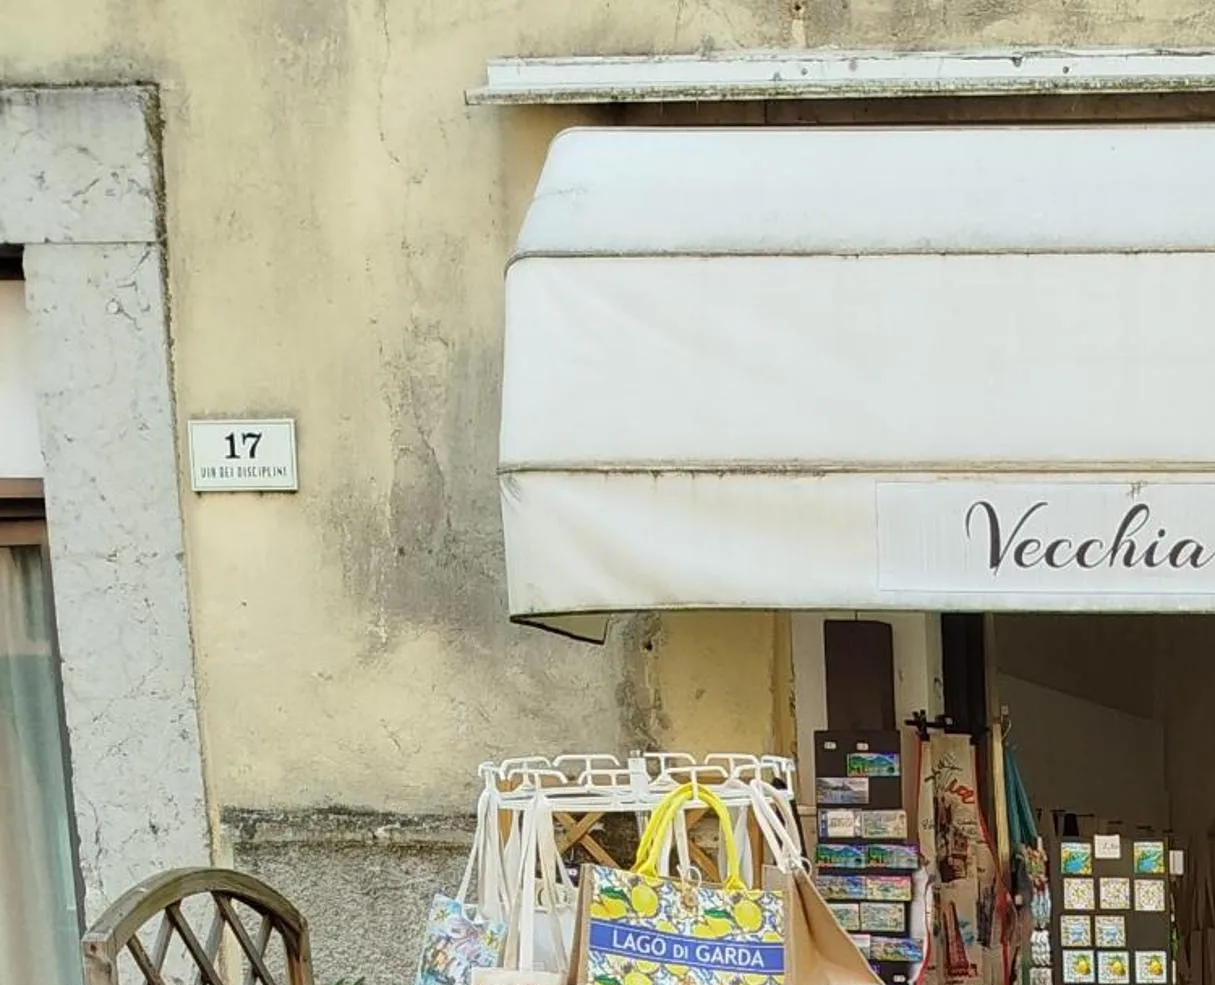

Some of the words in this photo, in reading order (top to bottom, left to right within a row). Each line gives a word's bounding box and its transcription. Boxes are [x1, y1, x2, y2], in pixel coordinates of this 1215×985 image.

[224, 432, 262, 459] 17
[201, 466, 216, 478] VIA
[219, 466, 234, 478] DEI
[965, 501, 1215, 576] Vecchia
[612, 929, 667, 957] LAGO
[673, 945, 689, 959] DI
[695, 944, 765, 968] GARDA
